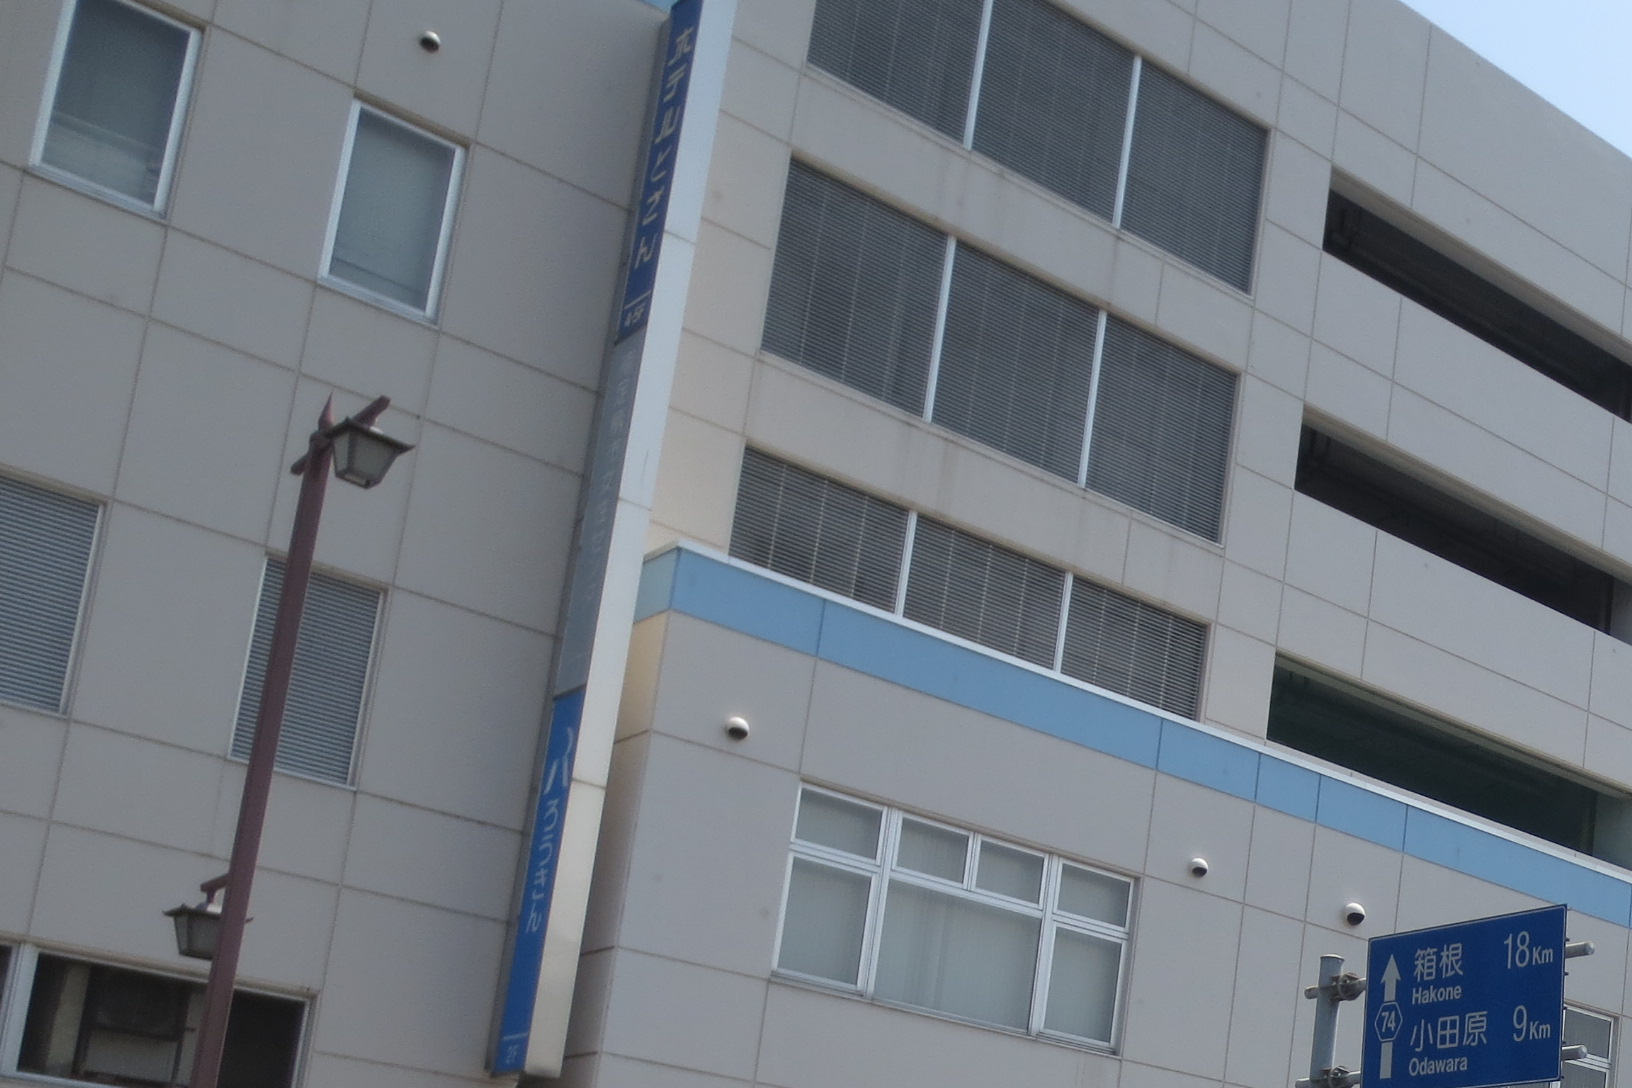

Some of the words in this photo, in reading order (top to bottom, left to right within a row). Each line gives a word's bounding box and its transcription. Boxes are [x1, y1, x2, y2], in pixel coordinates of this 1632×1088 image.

[1413, 943, 1464, 982] 箱根
[1412, 984, 1462, 1005] Hakone
[1381, 1012, 1396, 1032] 74
[1410, 1011, 1488, 1052] 小田原
[1408, 1057, 1468, 1076] Odawara
